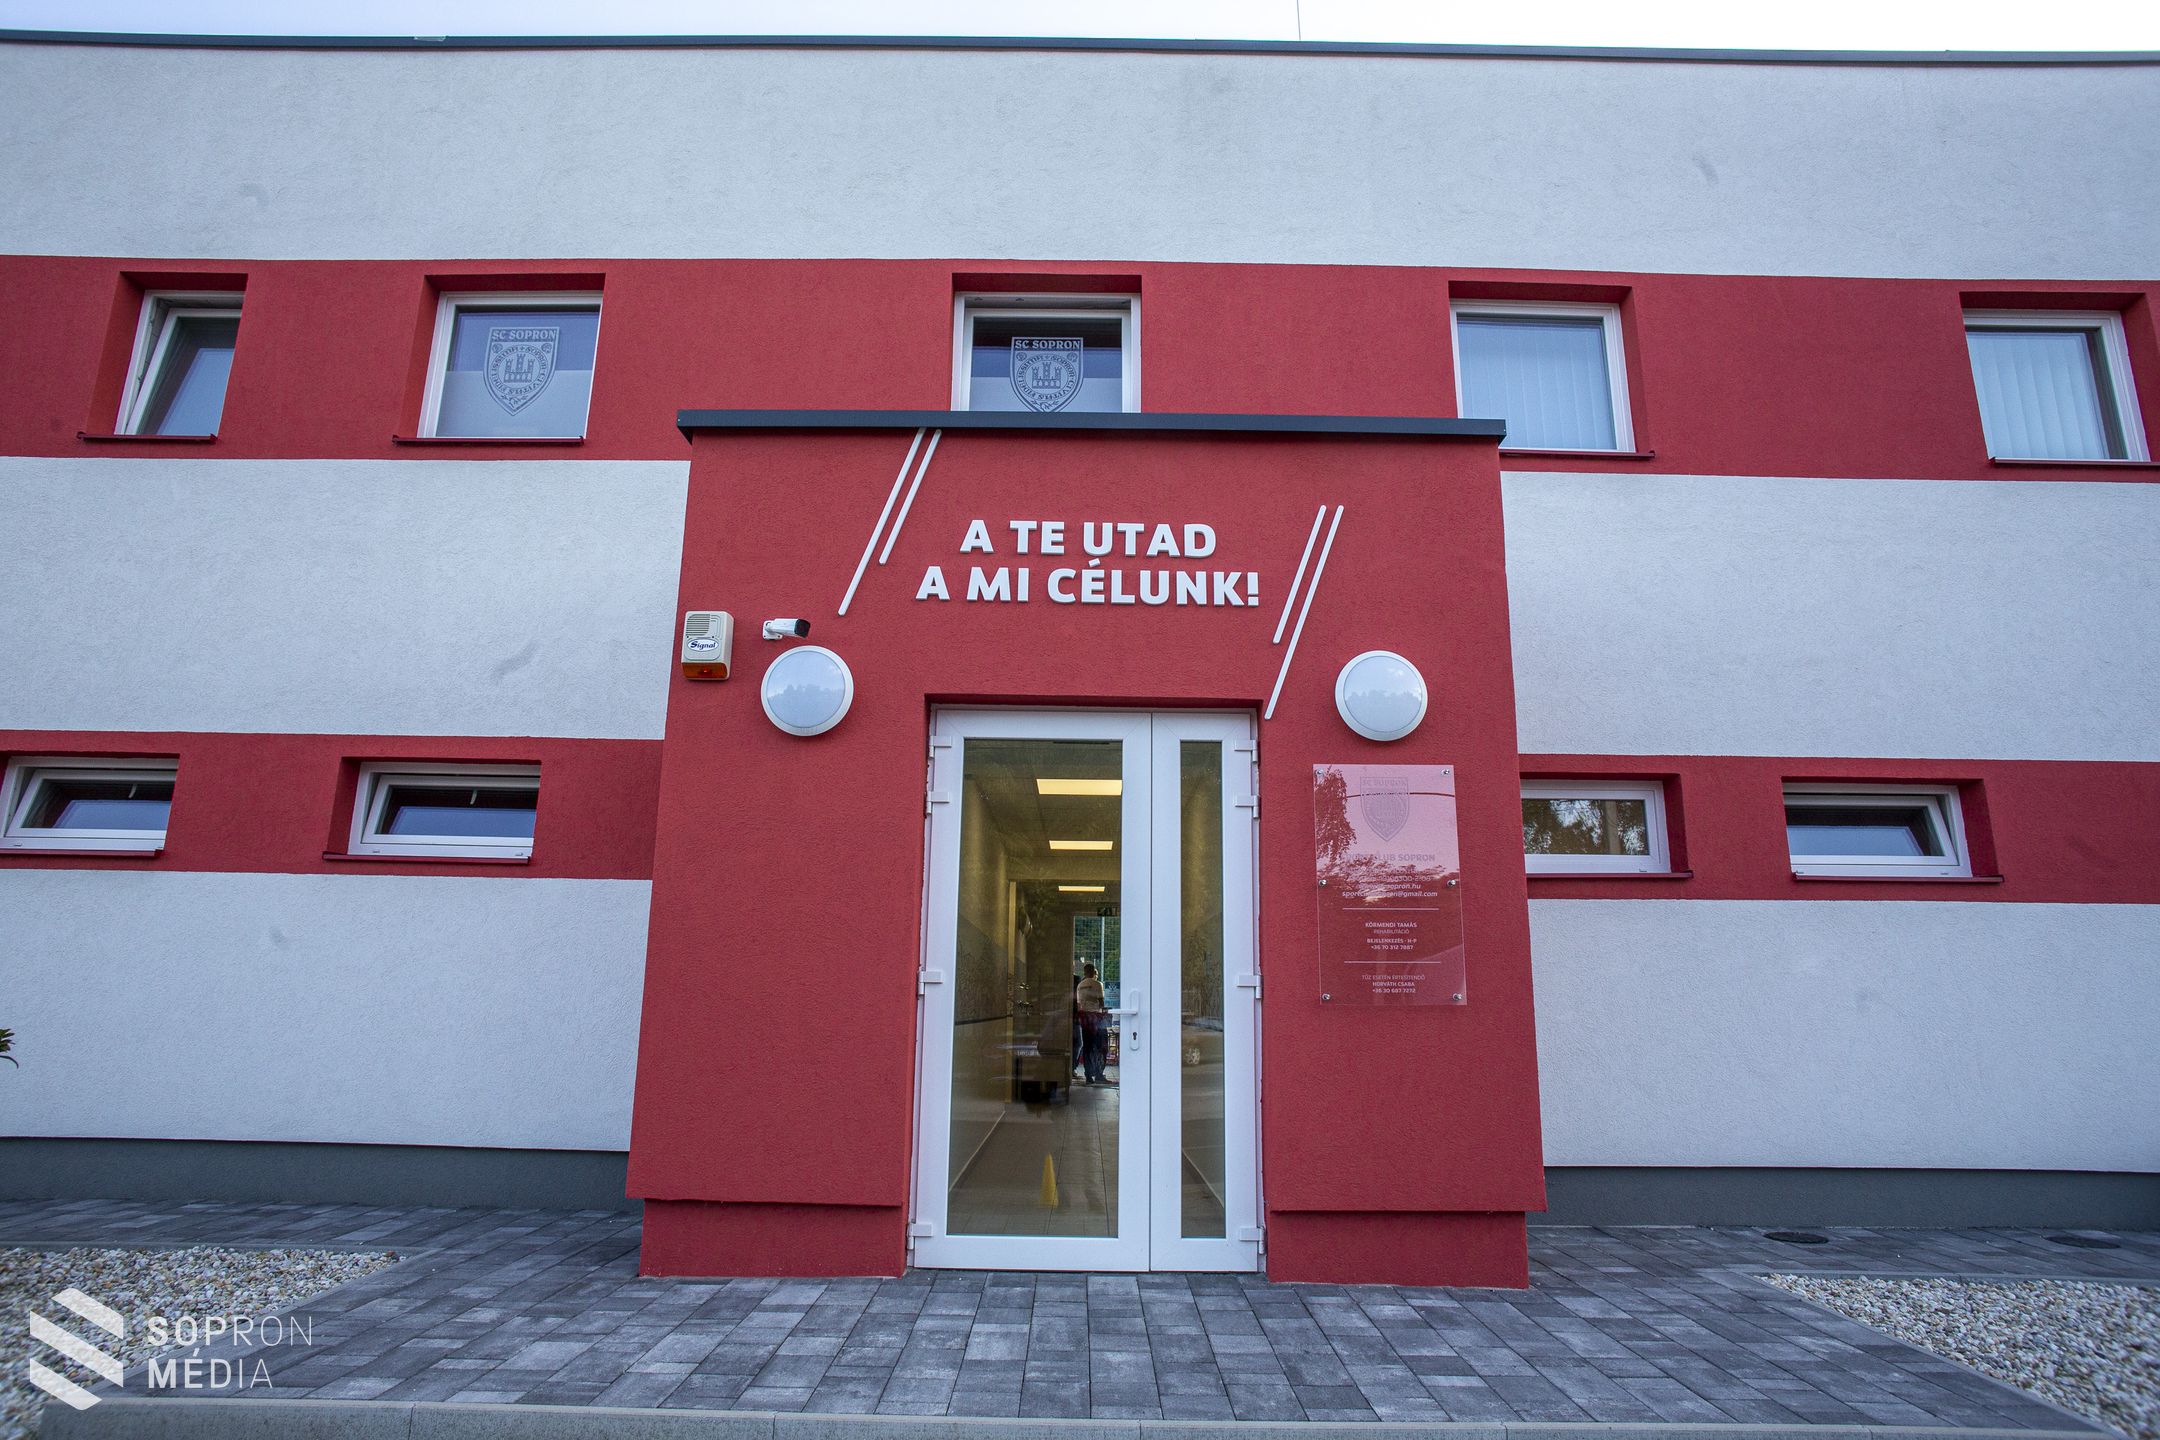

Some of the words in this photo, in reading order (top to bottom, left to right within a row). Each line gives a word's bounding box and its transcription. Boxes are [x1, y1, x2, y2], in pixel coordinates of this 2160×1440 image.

[491, 329, 506, 340] SC
[508, 329, 557, 340] SOPRON
[1014, 340, 1030, 349] SC
[1032, 340, 1080, 349] SOPRON
[959, 519, 995, 554] A
[1009, 520, 1065, 555] TE
[1083, 522, 1217, 558] UTAD
[915, 566, 950, 600] A
[966, 567, 1030, 602] MI
[1047, 557, 1260, 606] CÉLUNK!
[689, 641, 716, 650] Signal
[1398, 853, 1435, 862] SOPRON
